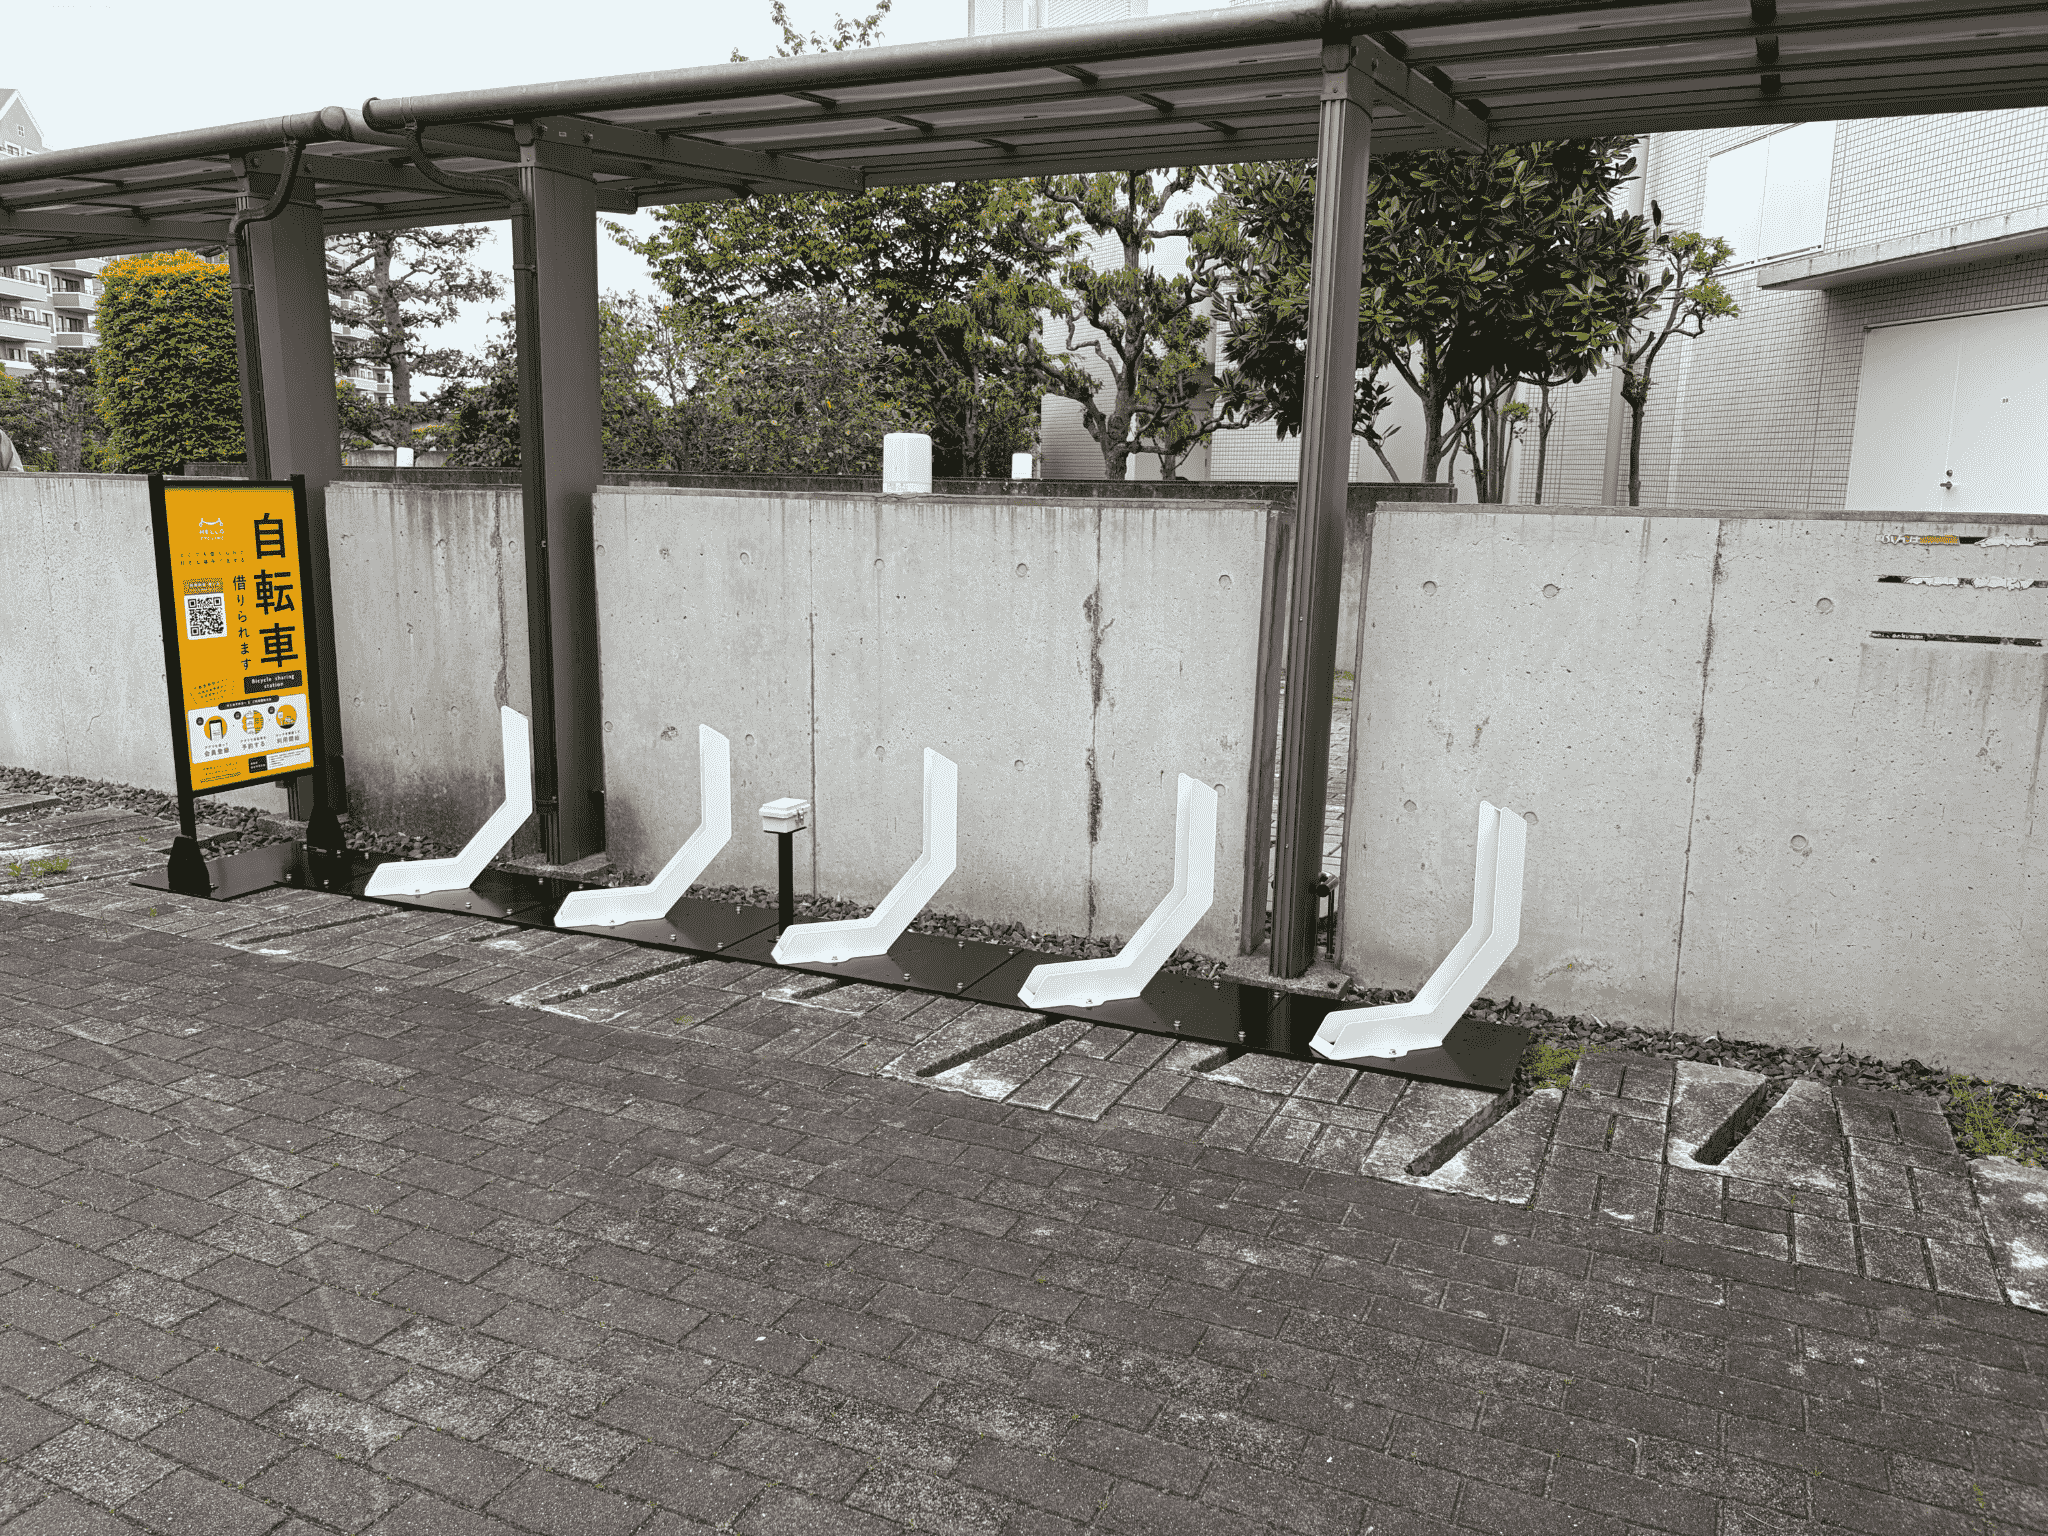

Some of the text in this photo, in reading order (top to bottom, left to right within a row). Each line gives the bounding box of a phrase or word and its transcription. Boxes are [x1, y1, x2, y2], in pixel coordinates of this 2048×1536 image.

[253, 512, 299, 668] 自転車
[232, 574, 252, 671] 借りられます
[251, 674, 295, 685] Bicycle sharing
[263, 681, 284, 689] station
